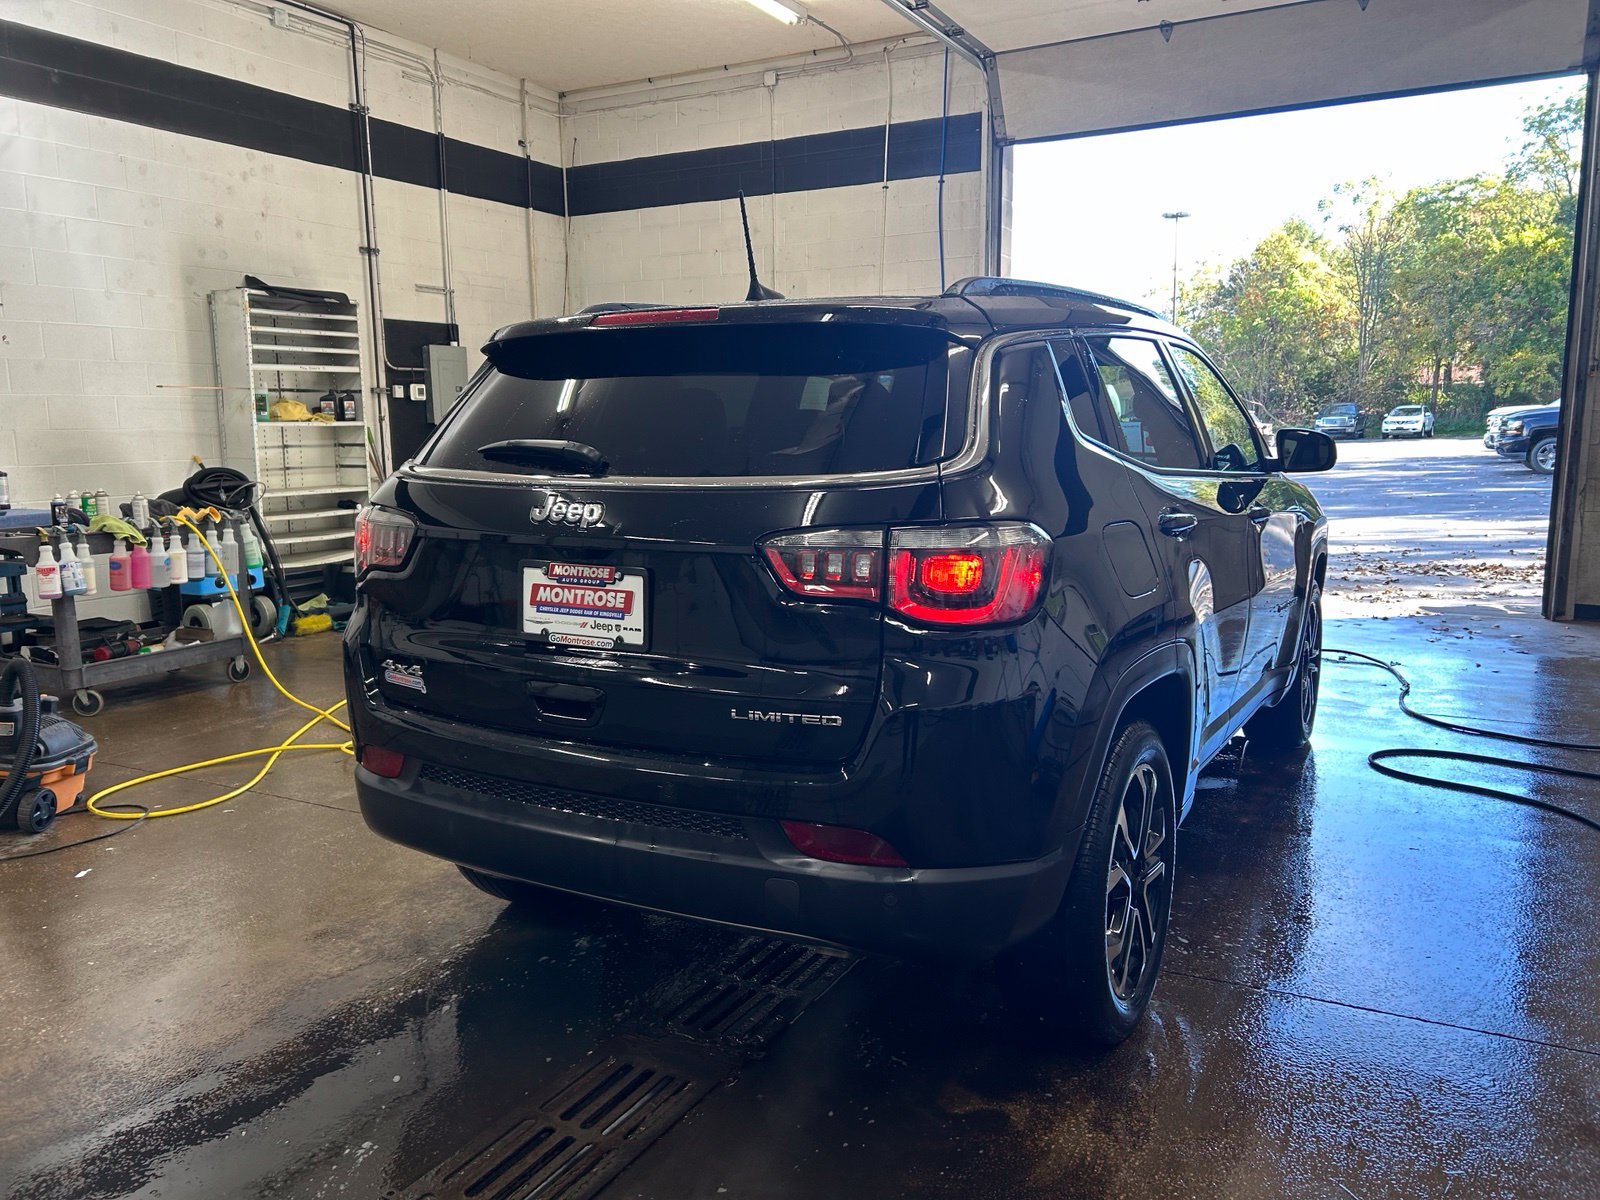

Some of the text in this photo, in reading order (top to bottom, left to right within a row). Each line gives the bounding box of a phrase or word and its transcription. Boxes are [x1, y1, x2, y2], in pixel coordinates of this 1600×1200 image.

[530, 492, 605, 528] Jeep
[553, 565, 610, 579] MONTROSE
[537, 587, 626, 608] MONTROSE
[590, 620, 613, 633] Jeep
[550, 634, 613, 647] GoMontrose.com
[731, 708, 842, 726] LIMITED
